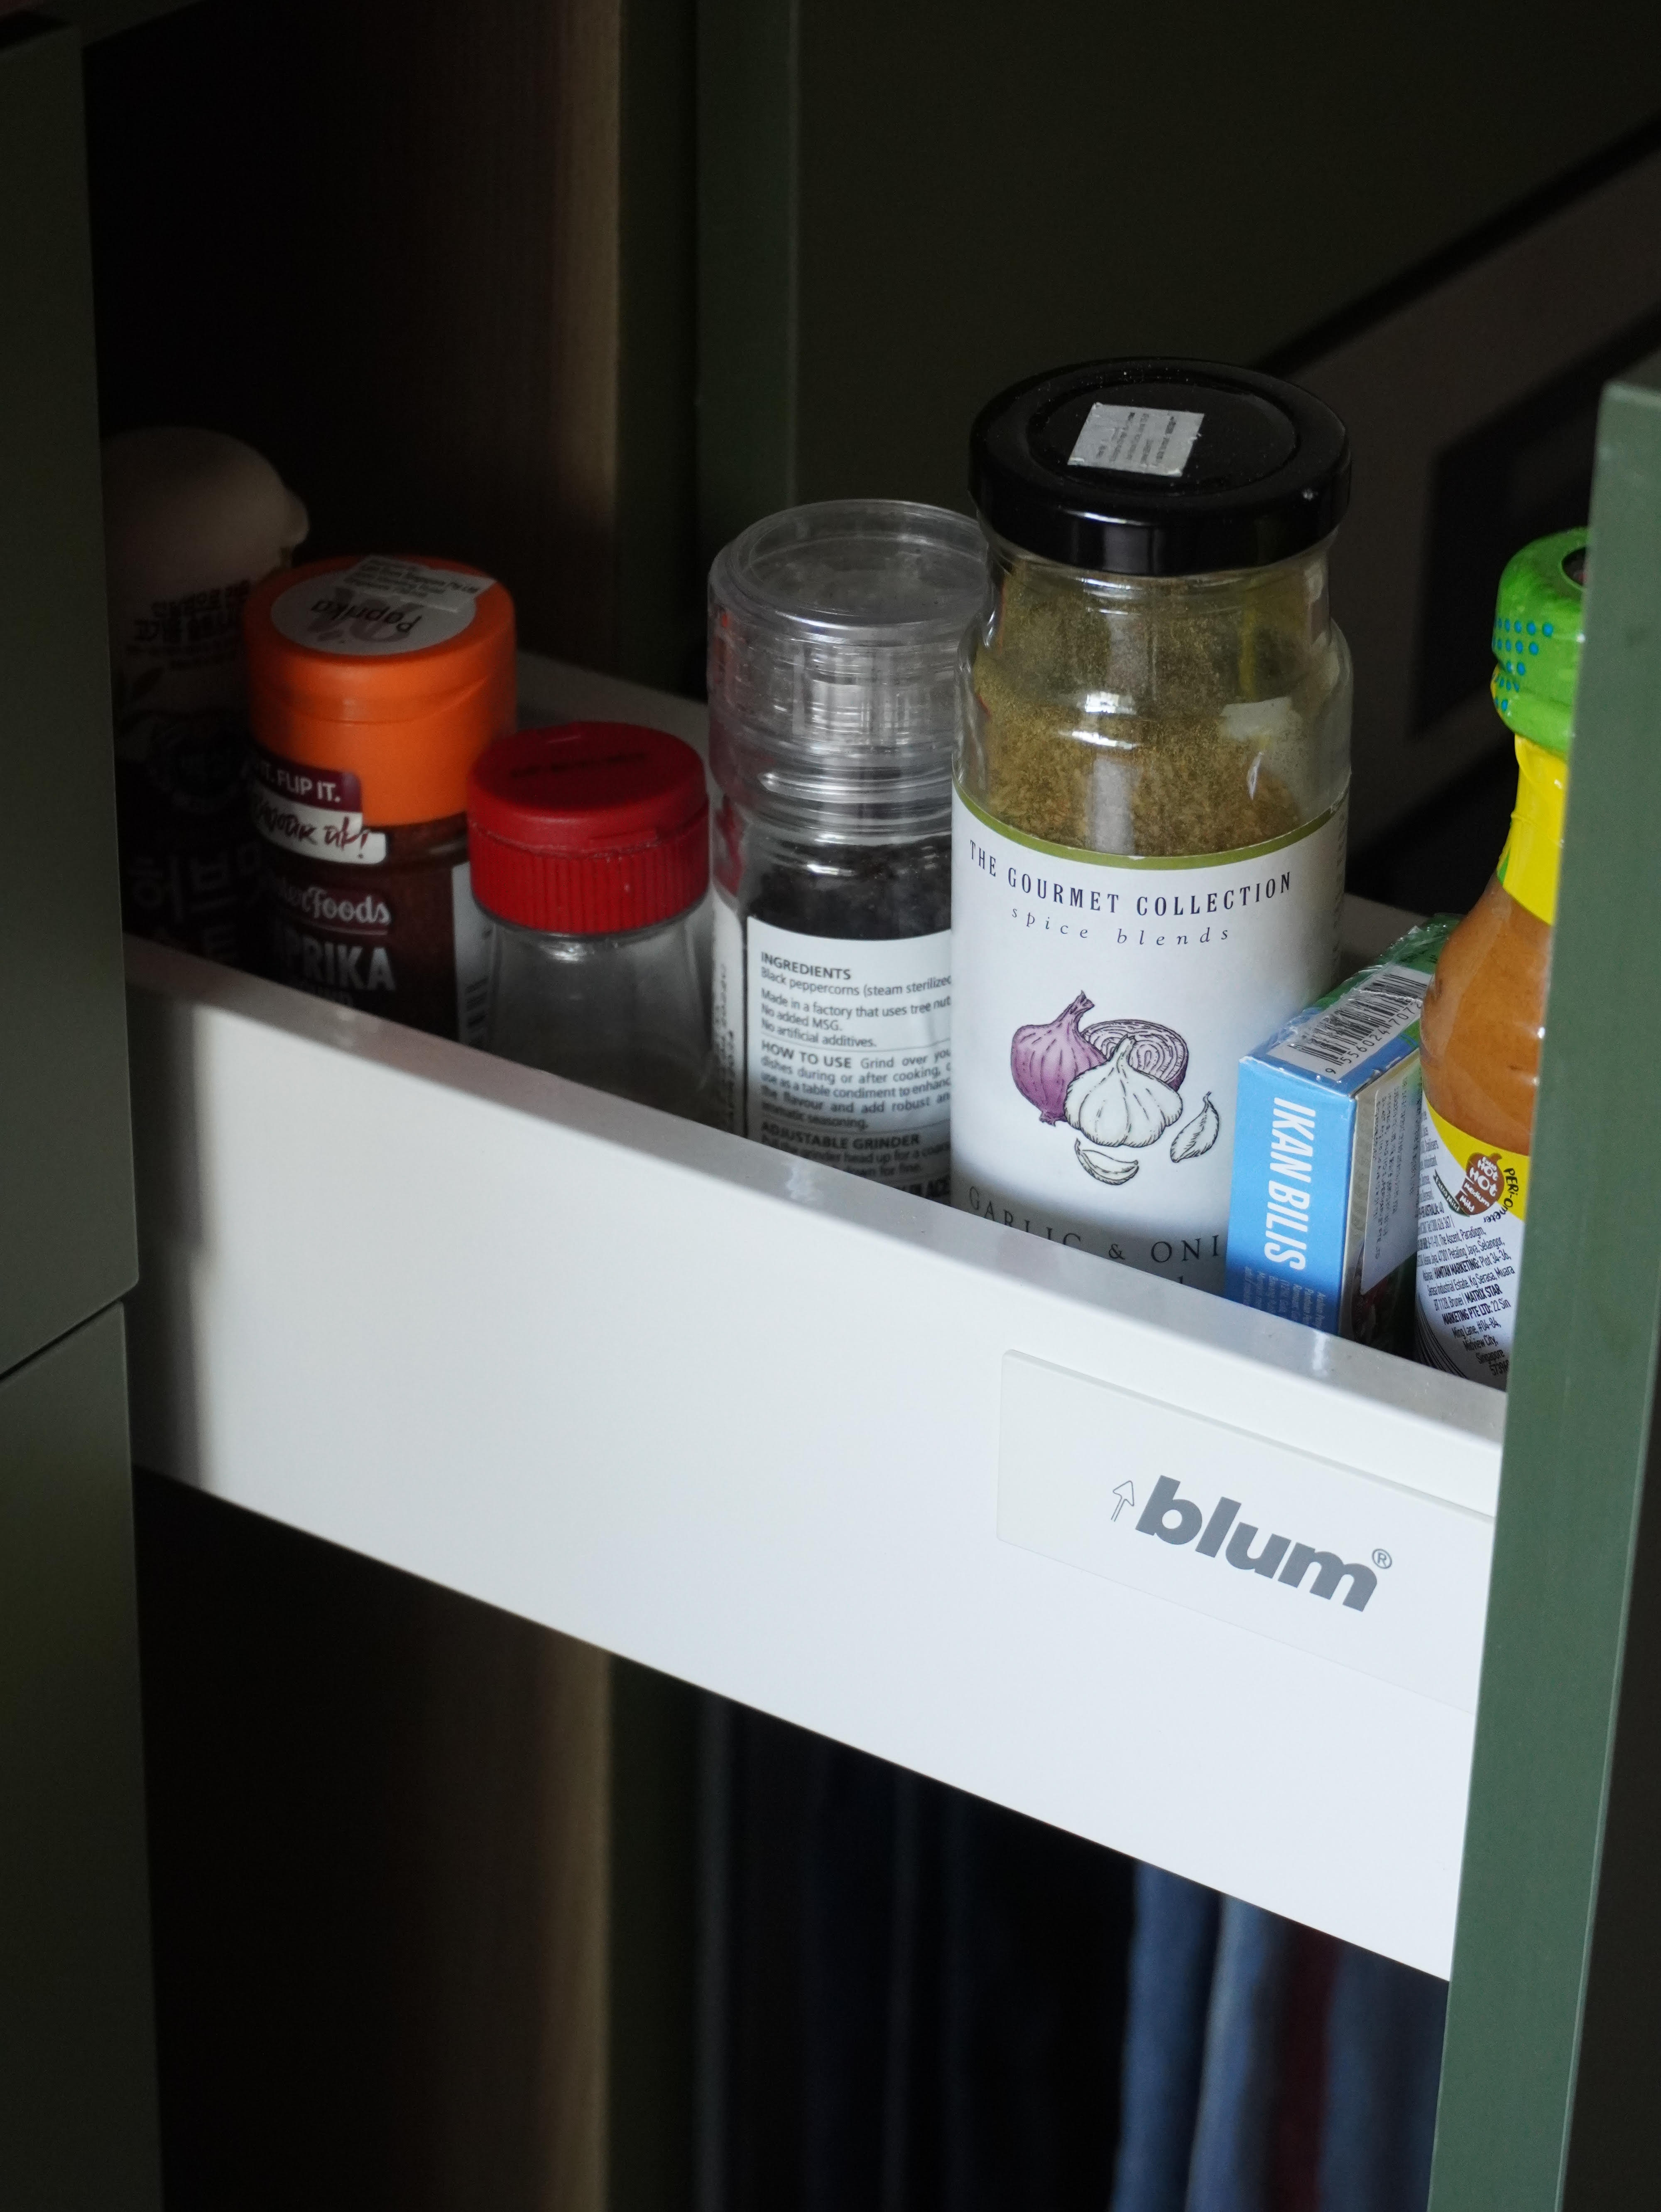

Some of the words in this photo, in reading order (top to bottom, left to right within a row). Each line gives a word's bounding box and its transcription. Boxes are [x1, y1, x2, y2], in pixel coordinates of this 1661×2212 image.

[310, 600, 423, 633] Paprika
[276, 768, 313, 796] FLIP
[316, 780, 342, 803] IT.
[969, 839, 997, 878] THE
[1006, 867, 1120, 914] GOURMET
[1136, 871, 1291, 917] COLLECTION
[1010, 907, 1089, 939] spice
[1117, 927, 1229, 947] blends
[761, 952, 851, 980] INGREDIENTS
[761, 967, 786, 984] Black
[789, 978, 860, 996] peppercorns
[863, 984, 903, 997] (steam
[761, 987, 788, 1006] Made
[790, 997, 801, 1010] in
[803, 1003, 810, 1012] a
[812, 1001, 853, 1019] factory
[856, 1006, 879, 1018] that
[882, 1006, 907, 1017] uses
[910, 1001, 931, 1014] tree
[761, 1003, 775, 1017] No
[777, 1010, 808, 1028] added
[812, 1018, 843, 1032] MSG.
[761, 1018, 775, 1032] No
[777, 1025, 819, 1043] artificial
[822, 1033, 877, 1048] additives.
[761, 1040, 794, 1060] HOW
[799, 1050, 819, 1065] TO
[823, 1056, 852, 1069] USE
[860, 1057, 894, 1070] Grind
[902, 1055, 928, 1067] over
[761, 1056, 793, 1075] dishes
[797, 1067, 835, 1085] during
[840, 1074, 854, 1083] or
[858, 1072, 888, 1084] after
[892, 1064, 941, 1082] cooking,
[779, 1077, 791, 1088] as
[793, 1082, 800, 1091] a
[802, 1082, 830, 1097] table
[833, 1086, 896, 1099] condiment
[899, 1086, 911, 1098] to
[783, 1091, 824, 1111] flavour
[830, 1101, 855, 1114] and
[860, 1101, 884, 1114] add
[891, 1096, 931, 1113] robust
[761, 1121, 848, 1150] ADJUSTABLE
[852, 1133, 920, 1150] GRINDER
[1269, 1097, 1316, 1183] IKAN
[1459, 1195, 1475, 1213] Mild
[1264, 1180, 1311, 1270] BILIS
[1460, 1226, 1487, 1241] Paradigm,
[1108, 1243, 1125, 1261] &
[1448, 1243, 1468, 1260] Petaling
[1466, 1243, 1481, 1257] Jaya,
[1477, 1236, 1505, 1252] Selangor,
[1449, 1257, 1482, 1275] MARKETING:
[1479, 1254, 1492, 1267] Plot
[1490, 1248, 1512, 1264] 34-36,
[1468, 1275, 1477, 1288] Kg
[1475, 1271, 1497, 1283] Serasa,
[1494, 1265, 1515, 1279] Muara
[1464, 1287, 1486, 1303] MATRIX
[1484, 1283, 1503, 1298] STAR
[1441, 1308, 1470, 1326] MARKETING
[1467, 1306, 1481, 1319] PTE
[1478, 1302, 1494, 1316] LTD:
[1490, 1299, 1501, 1313] 22
[1498, 1297, 1512, 1310] Sin
[1451, 1325, 1466, 1340] Ming
[1463, 1324, 1479, 1337] Lane,
[1476, 1316, 1502, 1333] #04-84,
[1462, 1336, 1485, 1353] Midview
[1484, 1334, 1499, 1348] City,
[1475, 1348, 1506, 1365] Singapore
[1135, 1474, 1378, 1613] blum
